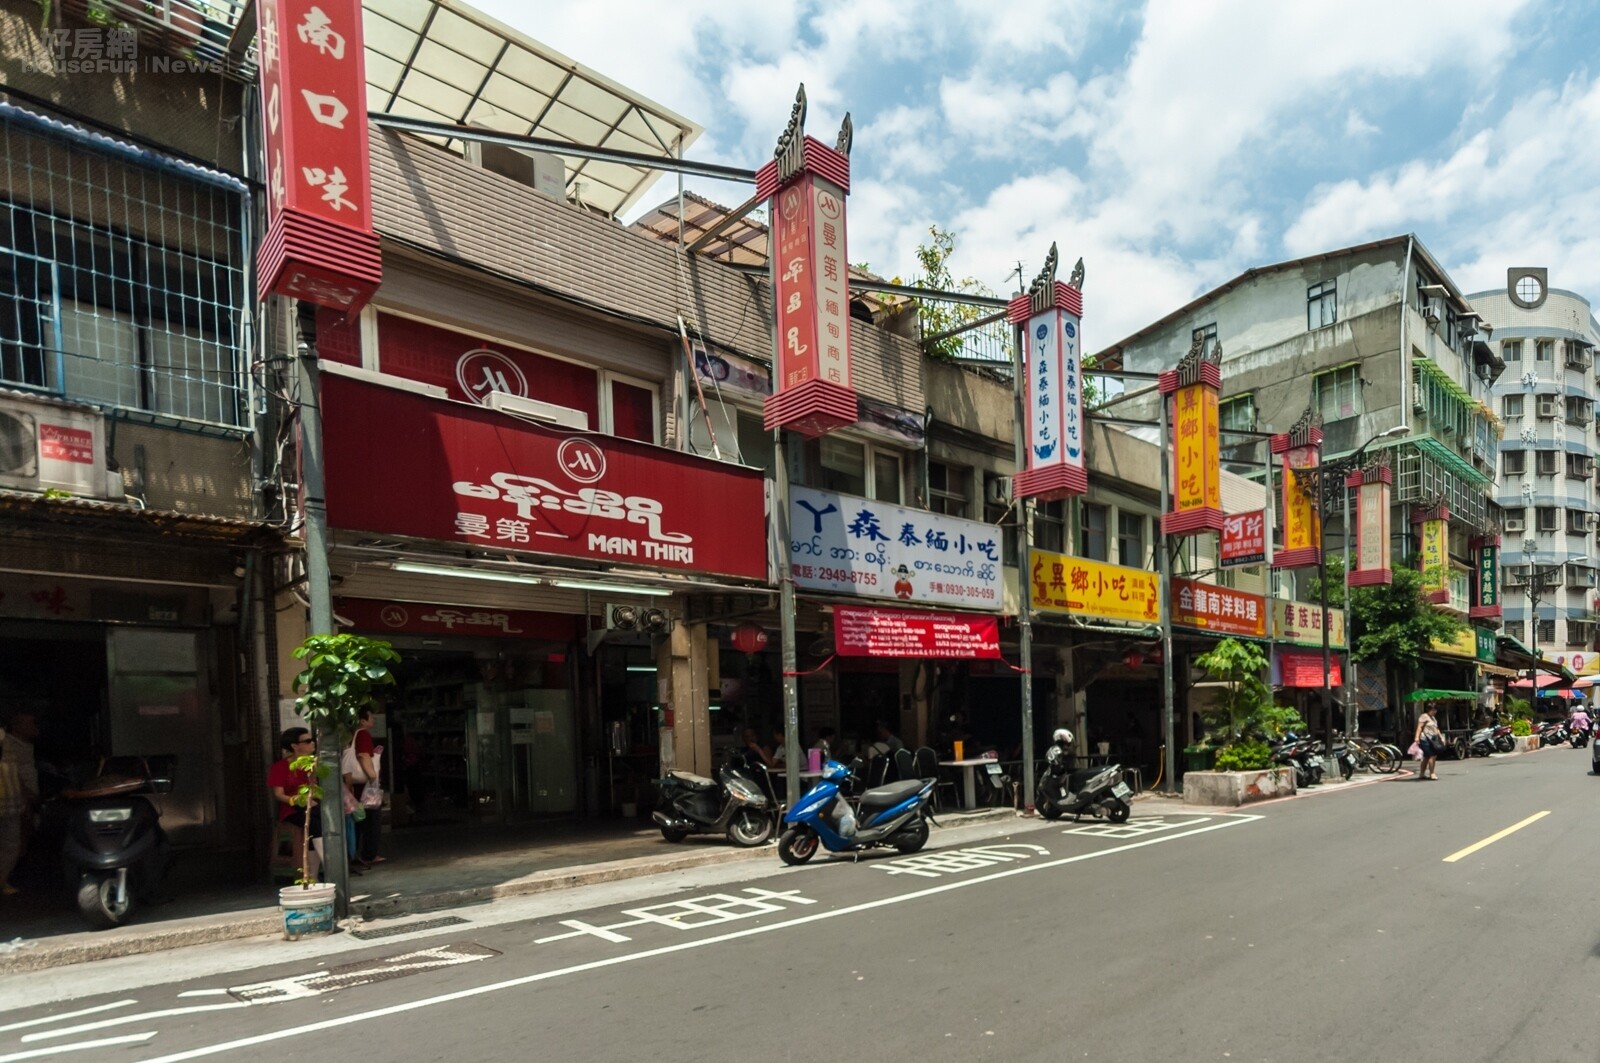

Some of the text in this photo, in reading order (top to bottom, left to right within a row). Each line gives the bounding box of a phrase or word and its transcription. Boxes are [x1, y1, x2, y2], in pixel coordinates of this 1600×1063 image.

[297, 6, 358, 212] 南口味
[822, 222, 841, 384] 曼第一緬甸商店
[1181, 388, 1200, 497] 異鄉小吃
[454, 512, 569, 544] 曼第一
[588, 532, 694, 564] MAN THIRI
[1050, 562, 1130, 602] 異鄉小吃
[1180, 586, 1257, 621] 金龍南洋料理
